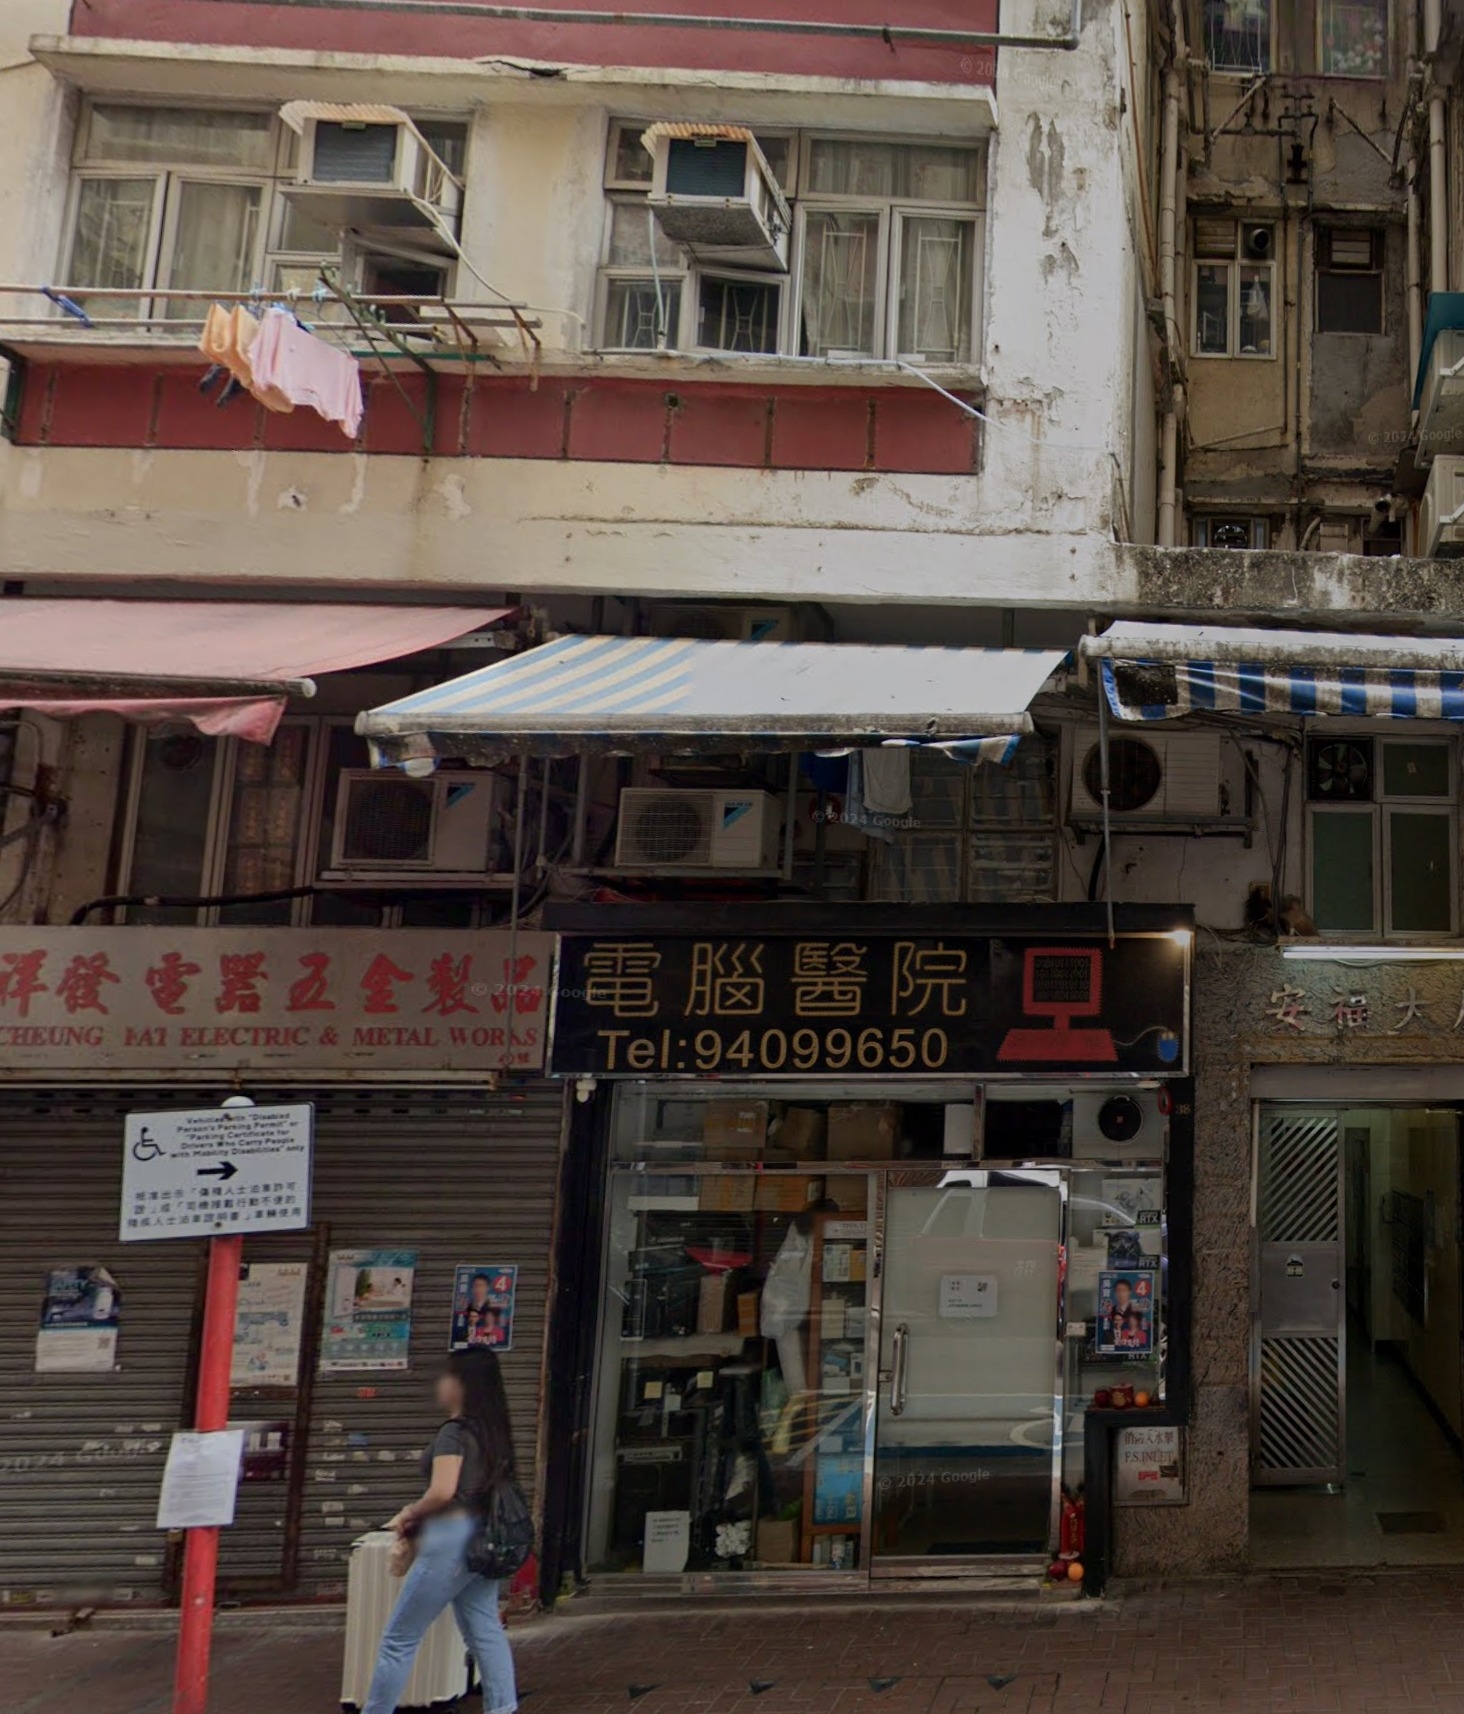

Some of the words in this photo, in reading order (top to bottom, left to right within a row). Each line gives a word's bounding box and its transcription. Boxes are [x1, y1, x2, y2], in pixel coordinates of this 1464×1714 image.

[584, 942, 967, 1018] 電腦醫院
[180, 1025, 310, 1047] ELECTRIC
[318, 1025, 338, 1046] &
[352, 1026, 440, 1047] METAL
[218, 1123, 252, 1132] Parking
[228, 1129, 275, 1139] Certificate
[181, 1141, 215, 1151] Drivers
[217, 1140, 237, 1148] Who
[239, 1138, 263, 1148] Carry
[265, 1136, 296, 1145] People
[170, 1150, 191, 1159] with
[193, 1148, 230, 1158] Mobility
[286, 1144, 305, 1154] only
[1139, 1214, 1159, 1224] RTX
[1138, 1259, 1158, 1269] RTX
[495, 1275, 507, 1292] 4
[1136, 1282, 1147, 1296] 4
